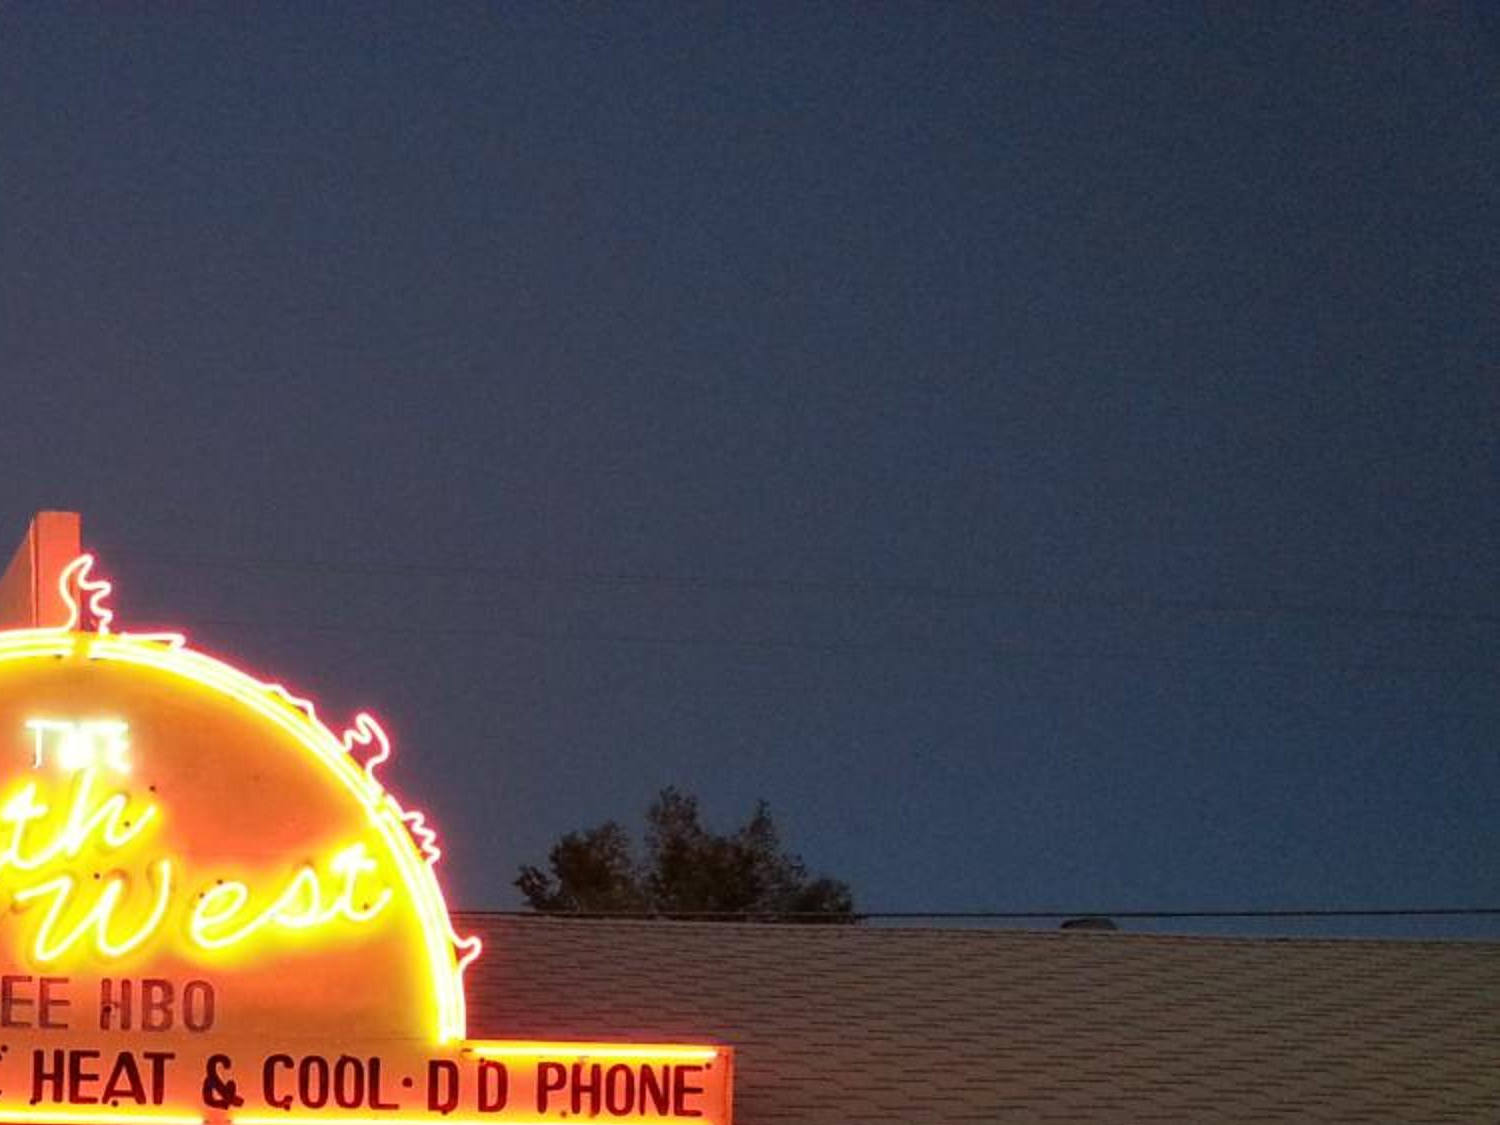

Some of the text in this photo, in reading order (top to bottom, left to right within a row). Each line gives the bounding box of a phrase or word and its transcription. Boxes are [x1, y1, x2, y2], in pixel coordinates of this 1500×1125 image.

[10, 840, 397, 962] West
[100, 977, 216, 1034] HBO
[29, 1049, 176, 1108] HEAT
[201, 1055, 245, 1111] &
[537, 1063, 706, 1118] PHONE
